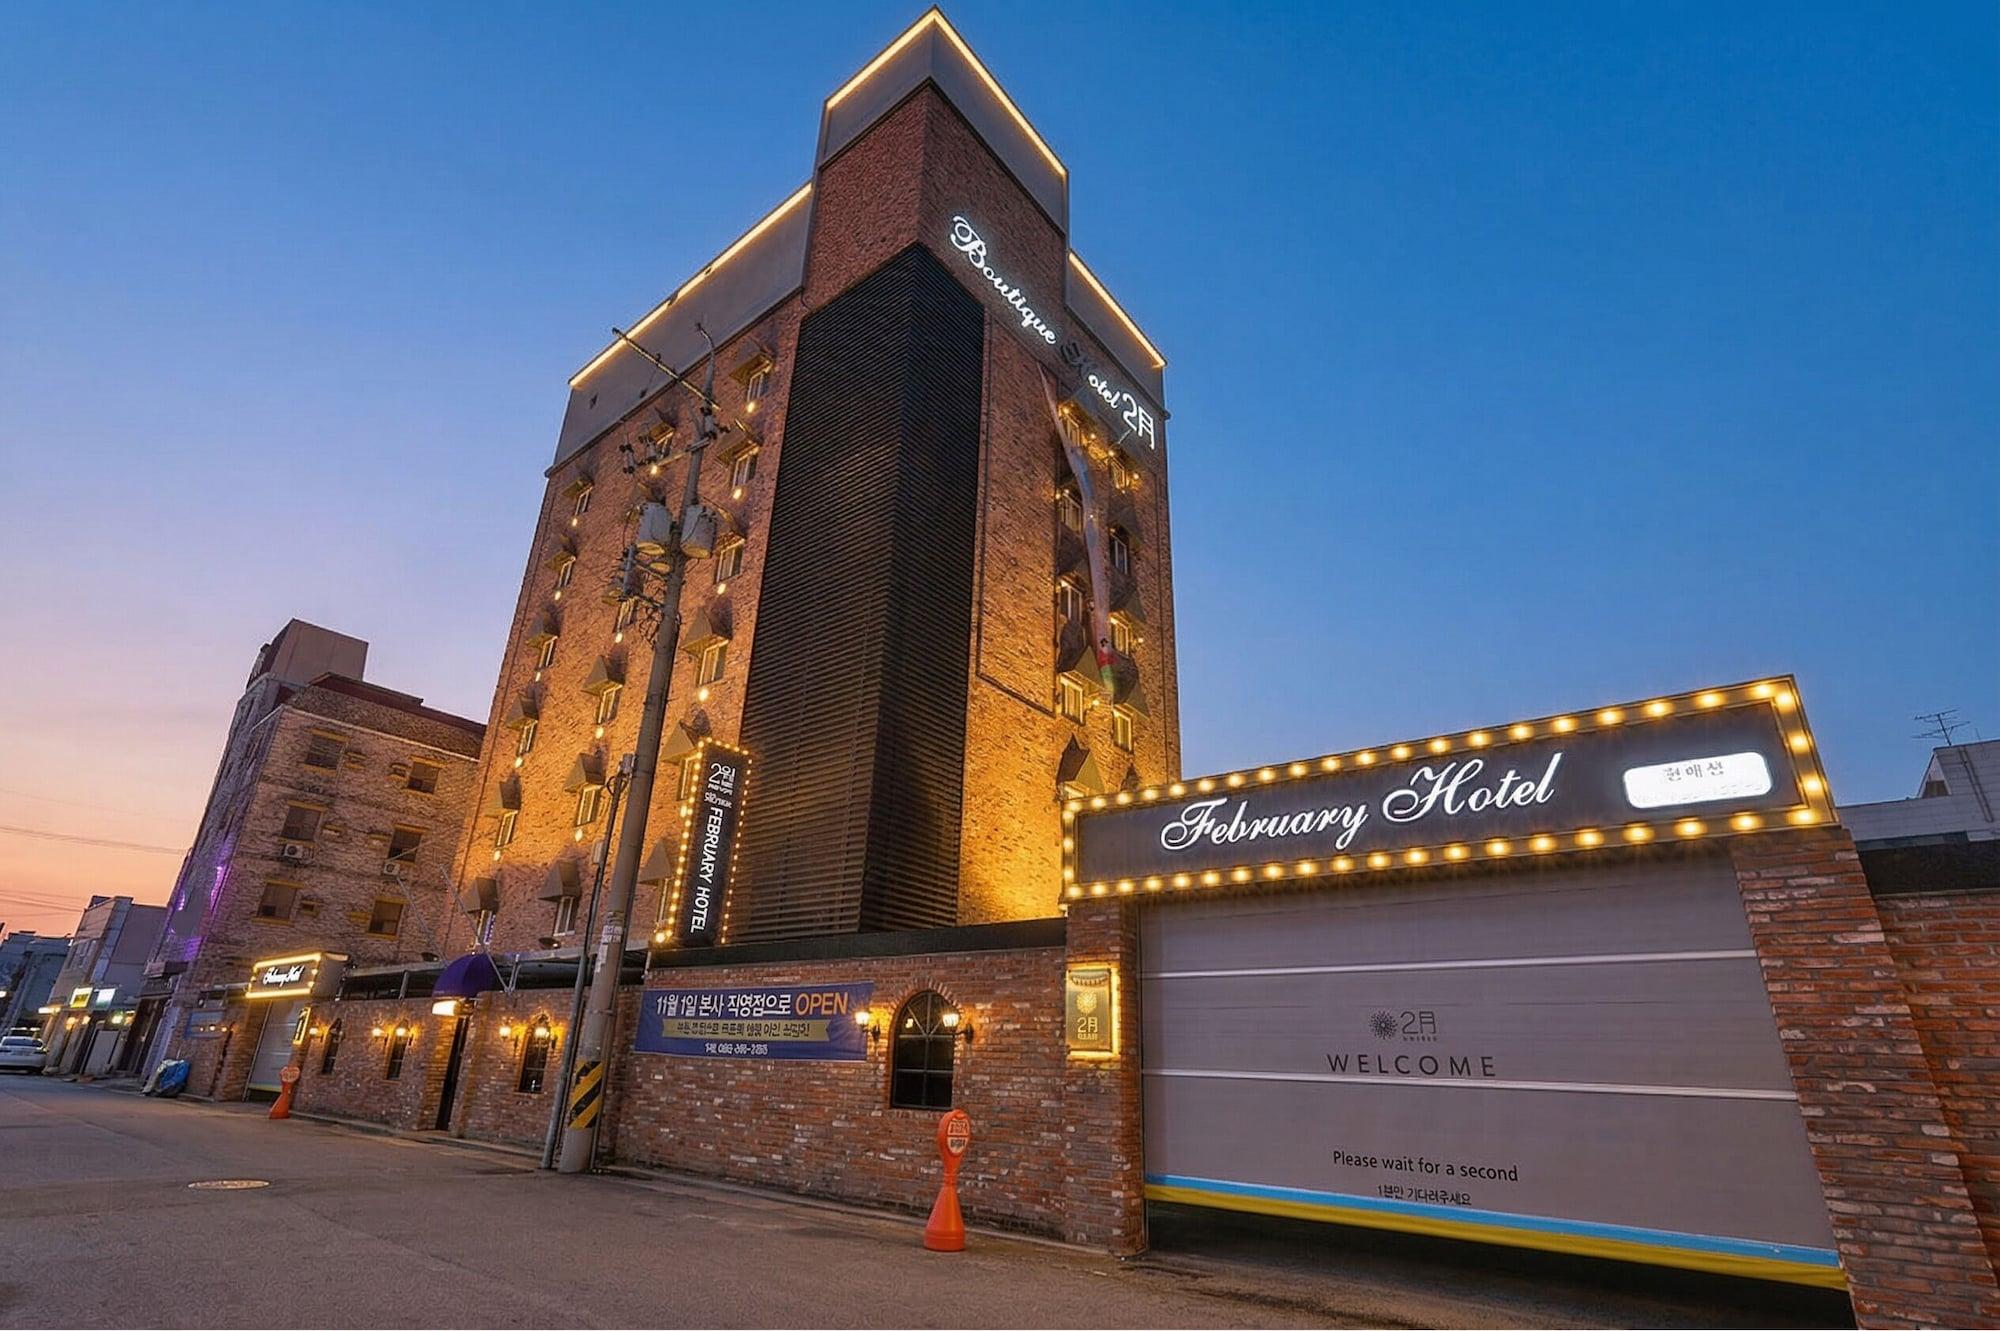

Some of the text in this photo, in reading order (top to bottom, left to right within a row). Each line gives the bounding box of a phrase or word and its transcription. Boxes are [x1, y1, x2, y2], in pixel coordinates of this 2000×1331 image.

[950, 215, 1056, 344] Boutique
[1160, 752, 1563, 850] February Hotel
[699, 806, 724, 884] FEBRUARY
[690, 886, 712, 934] HOTEL
[656, 992, 848, 1018] 11월 1일 본사 직영점으로 OPEN
[1327, 1053, 1496, 1077] WELCOME
[1333, 1150, 1519, 1181] Please wait for a second
